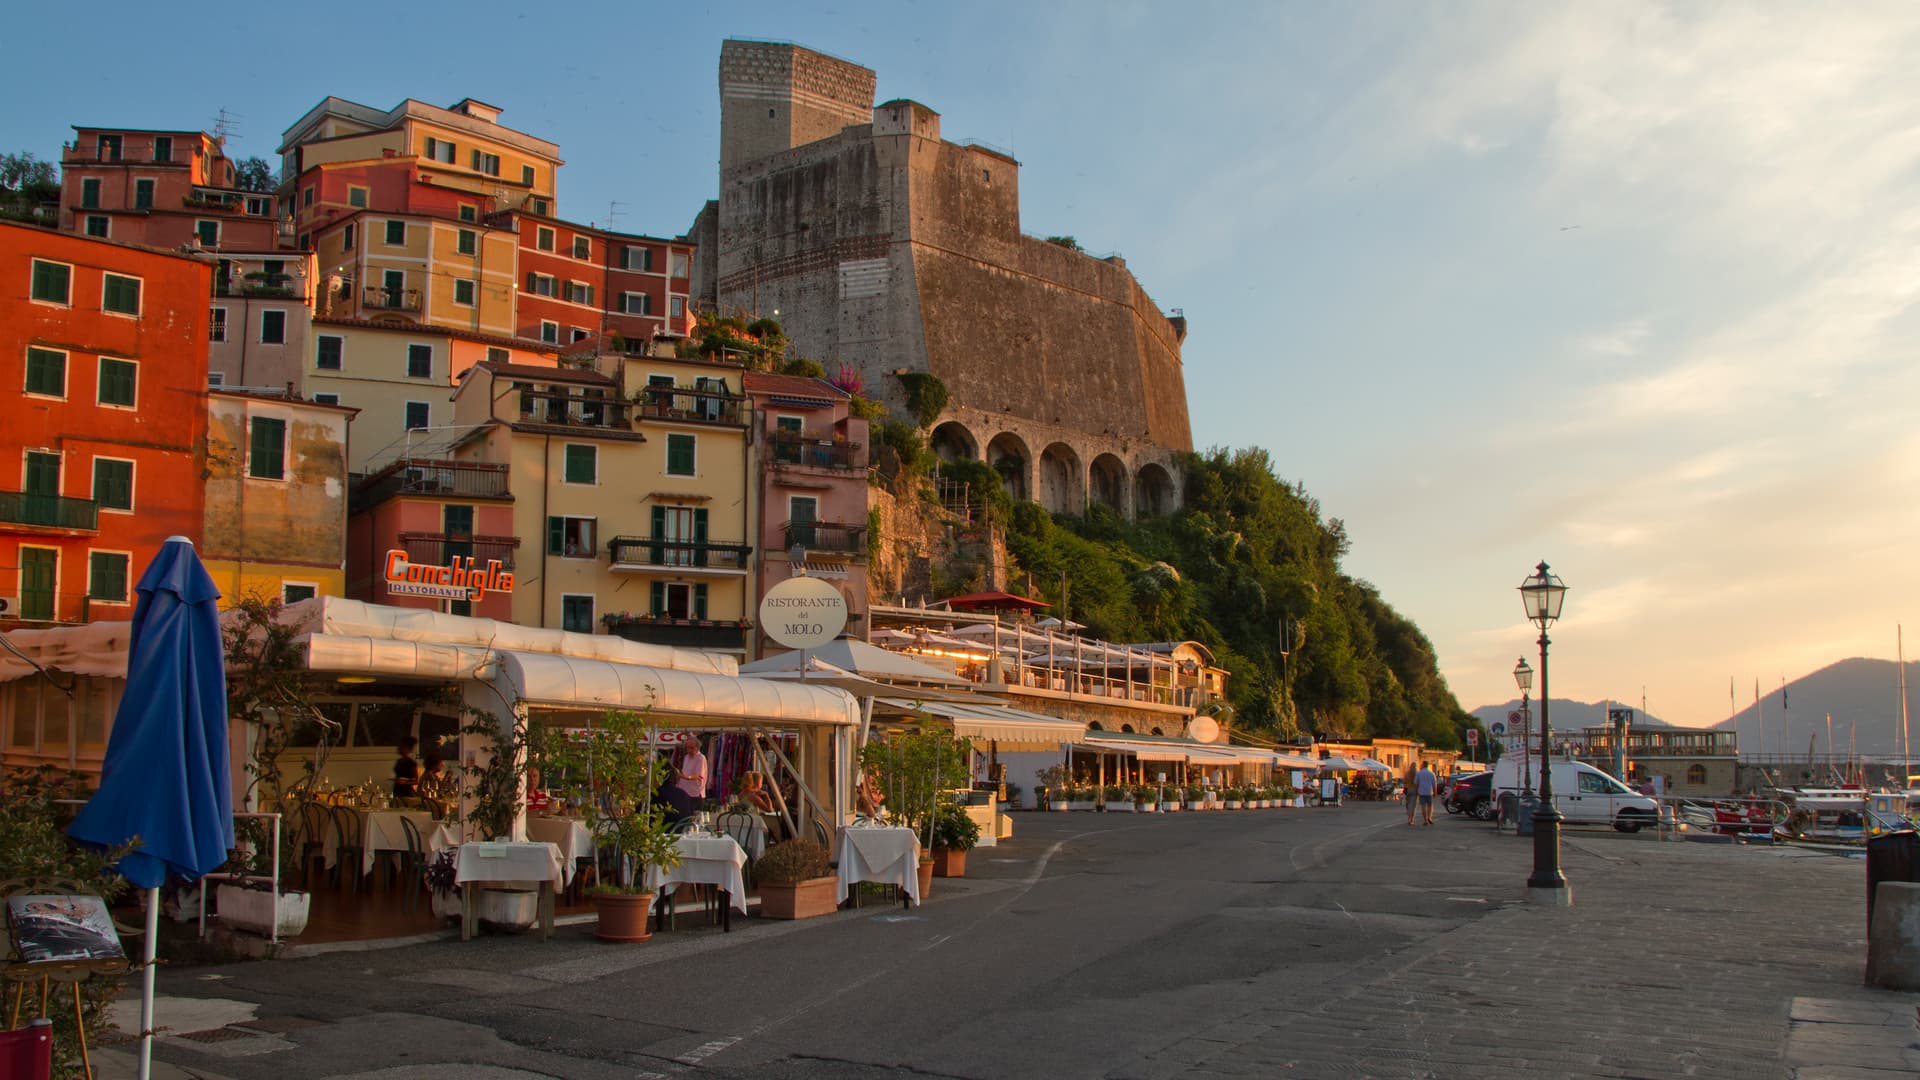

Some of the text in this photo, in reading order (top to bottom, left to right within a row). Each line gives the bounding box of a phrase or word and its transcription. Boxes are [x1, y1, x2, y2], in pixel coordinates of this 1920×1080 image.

[385, 549, 515, 601] Conchiglia
[392, 584, 465, 598] RISTORANTE
[767, 597, 840, 608] RISTORANTE
[798, 611, 808, 619] del
[784, 623, 823, 635] MOLO
